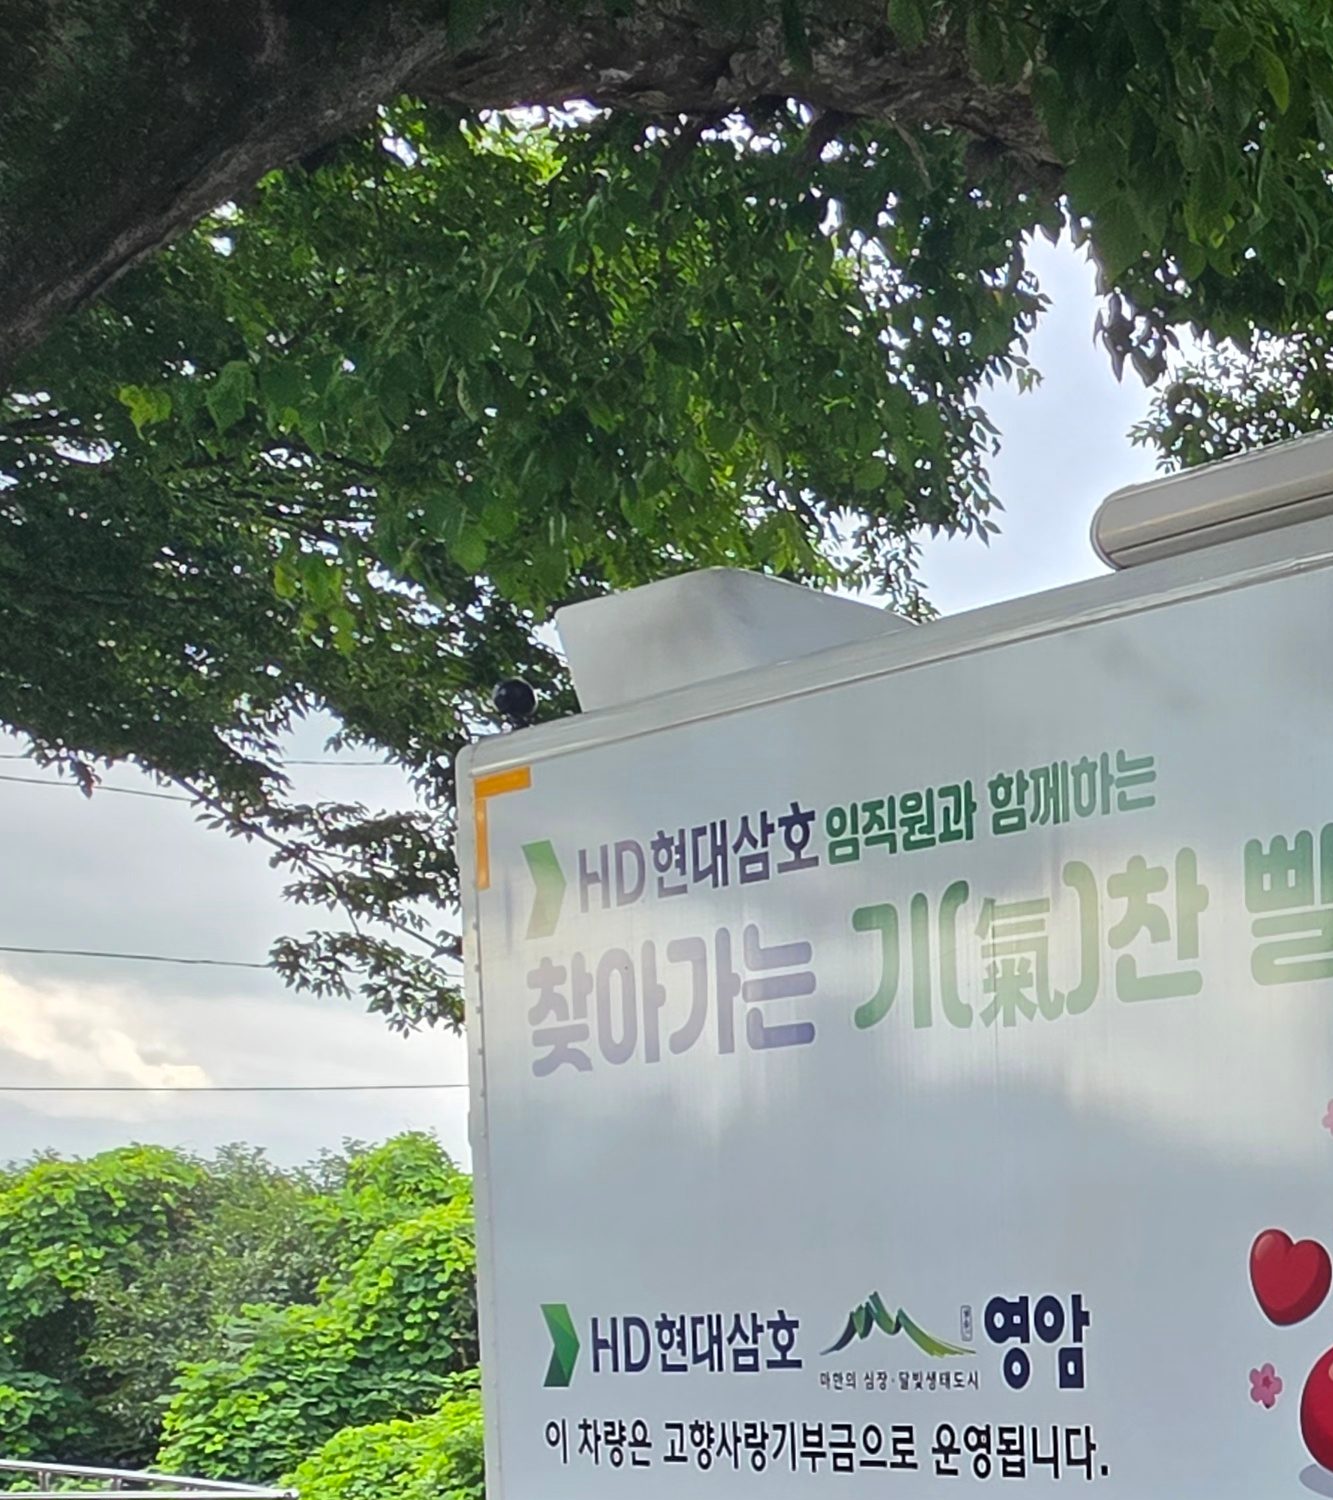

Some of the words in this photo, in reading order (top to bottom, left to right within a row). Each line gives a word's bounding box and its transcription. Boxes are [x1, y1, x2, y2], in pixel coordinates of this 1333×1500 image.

[577, 801, 819, 912] HD현대삼호
[826, 779, 976, 864] 임직원과
[987, 748, 1157, 836] 함께하는
[525, 923, 816, 1078] 찾아가는
[851, 846, 1210, 1031] 기(氣)찬
[591, 1308, 803, 1372] HD현대삼호
[984, 1294, 1091, 1390] 영암
[819, 1372, 857, 1390] 마한의
[545, 1419, 570, 1463] 이
[578, 1418, 652, 1467] 차량은
[662, 1419, 918, 1474] 고향사랑기부금으로
[931, 1422, 1110, 1480] 운영됩니다.
